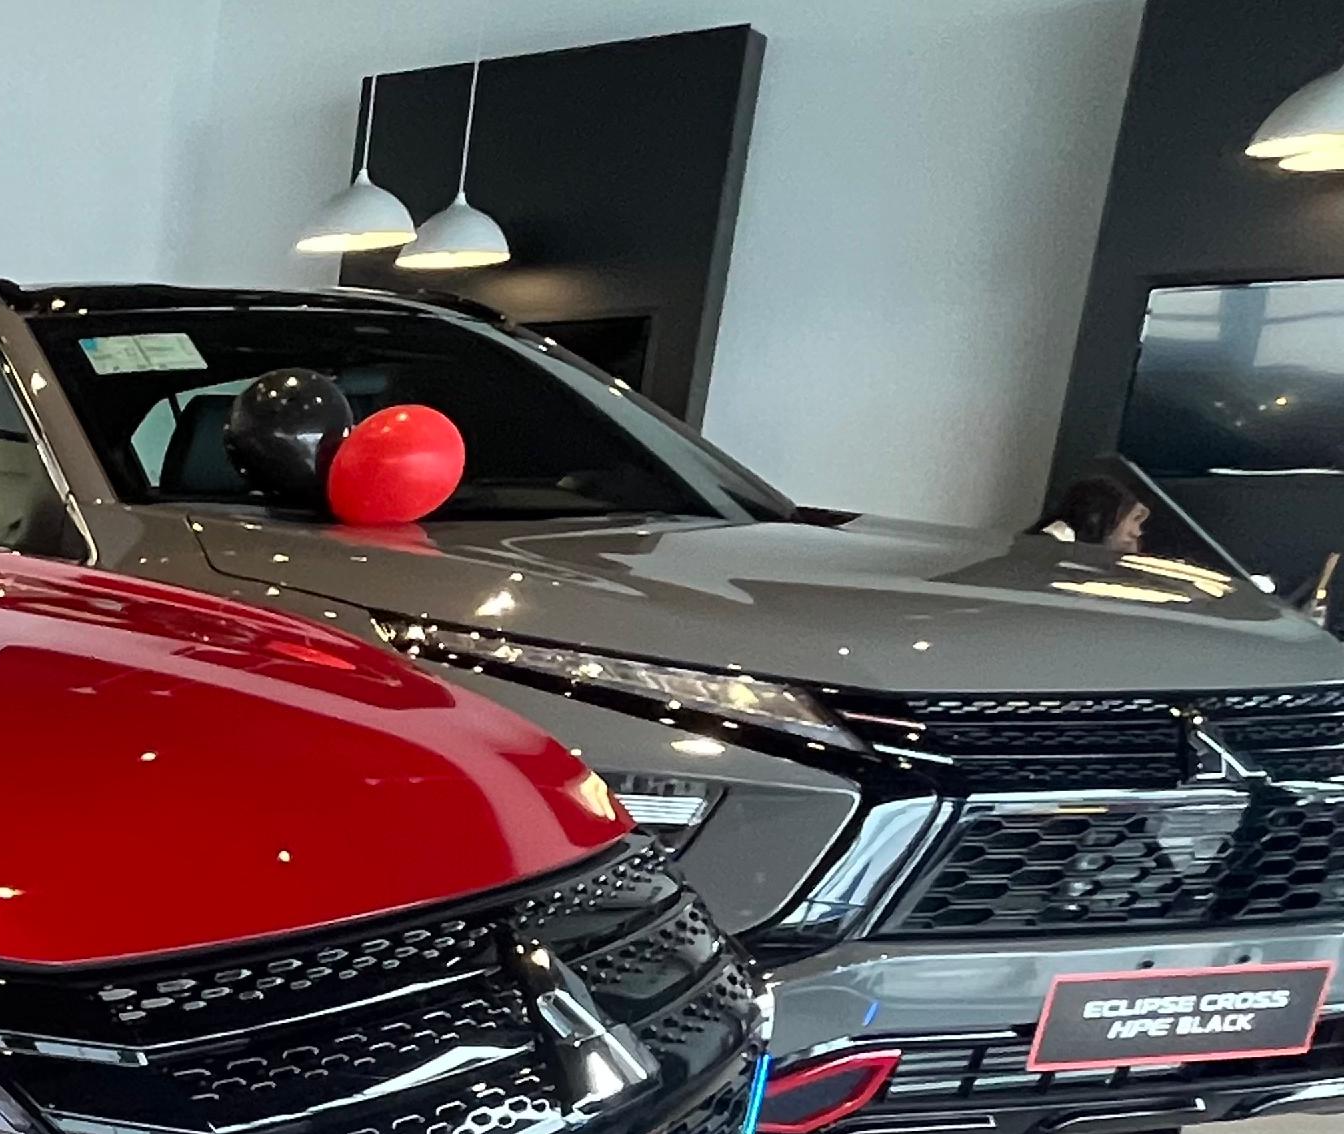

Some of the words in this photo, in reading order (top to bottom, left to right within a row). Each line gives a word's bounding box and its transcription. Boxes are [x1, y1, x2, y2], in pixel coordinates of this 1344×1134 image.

[1083, 996, 1197, 1019] ECLIPSE
[1199, 990, 1290, 1012] CROSS
[1107, 1017, 1175, 1040] HPE
[1176, 1013, 1255, 1035] BLACK
